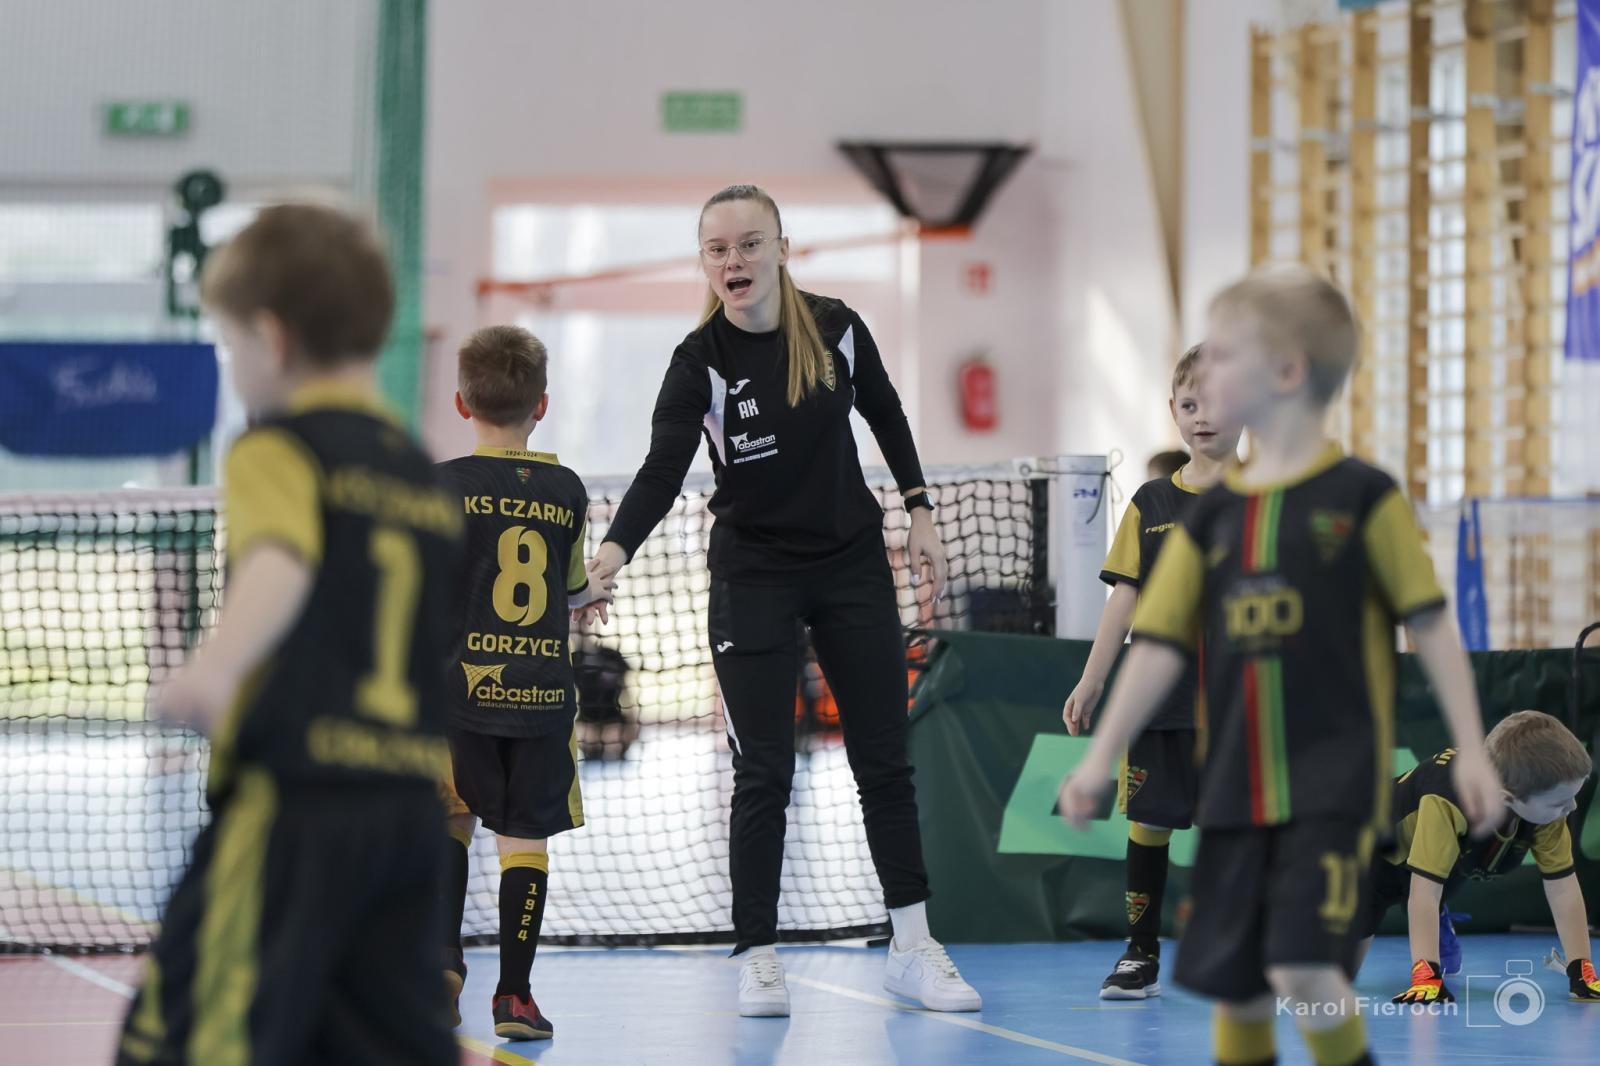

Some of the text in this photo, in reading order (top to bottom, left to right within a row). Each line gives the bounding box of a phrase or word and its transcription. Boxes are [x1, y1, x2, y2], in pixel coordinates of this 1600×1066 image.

[738, 397, 760, 420] AK
[505, 449, 538, 458] 1924-2024
[738, 434, 776, 450] abastran
[464, 495, 575, 529] KS CZARNI
[491, 524, 548, 627] 8
[355, 526, 423, 727] 1
[467, 632, 562, 657] GORZYCE
[476, 683, 565, 703] abastran
[477, 700, 518, 710] zadaszenia
[517, 882, 538, 942] 1924
